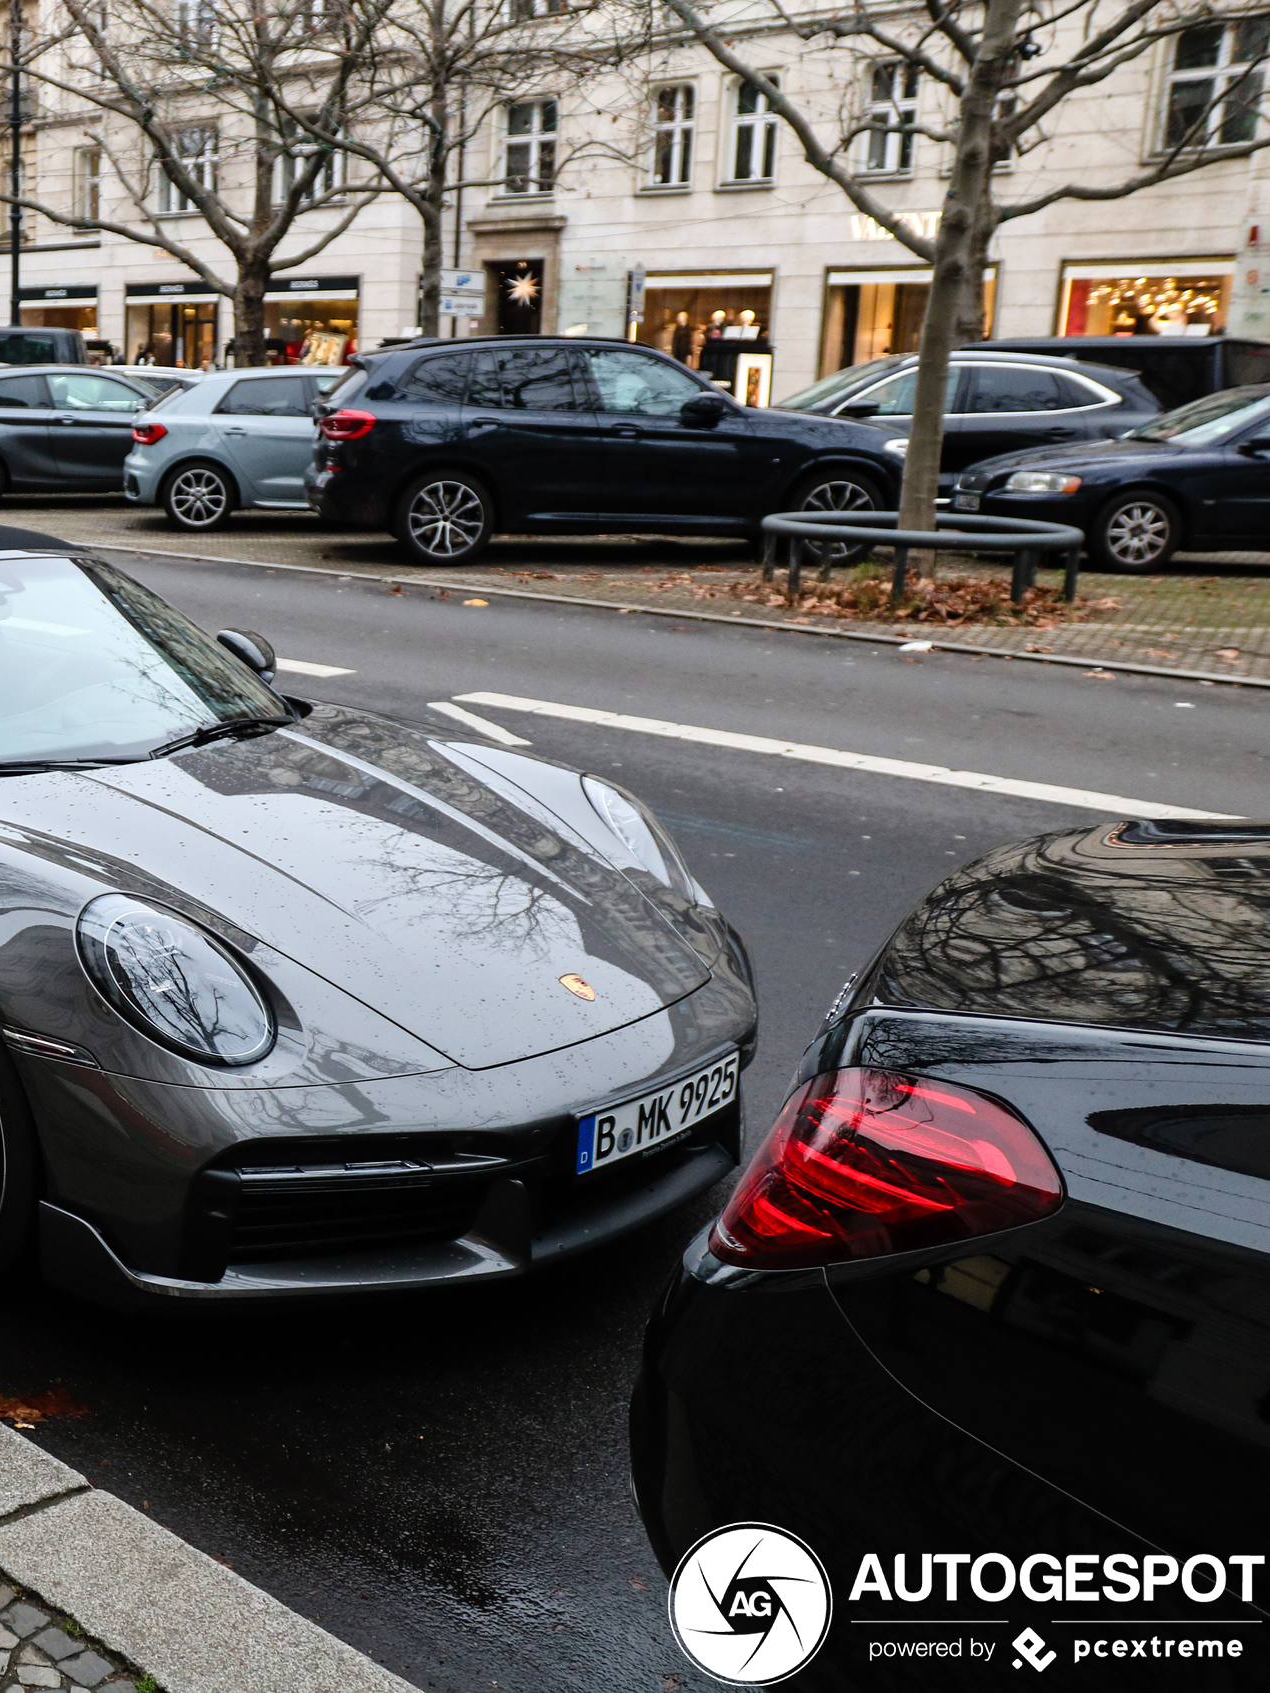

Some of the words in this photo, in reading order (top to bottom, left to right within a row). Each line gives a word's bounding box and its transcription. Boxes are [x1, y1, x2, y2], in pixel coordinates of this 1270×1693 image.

[596, 1115, 617, 1161] B
[636, 1090, 675, 1145] MK
[680, 1057, 737, 1125] 9925
[580, 1151, 589, 1165] D
